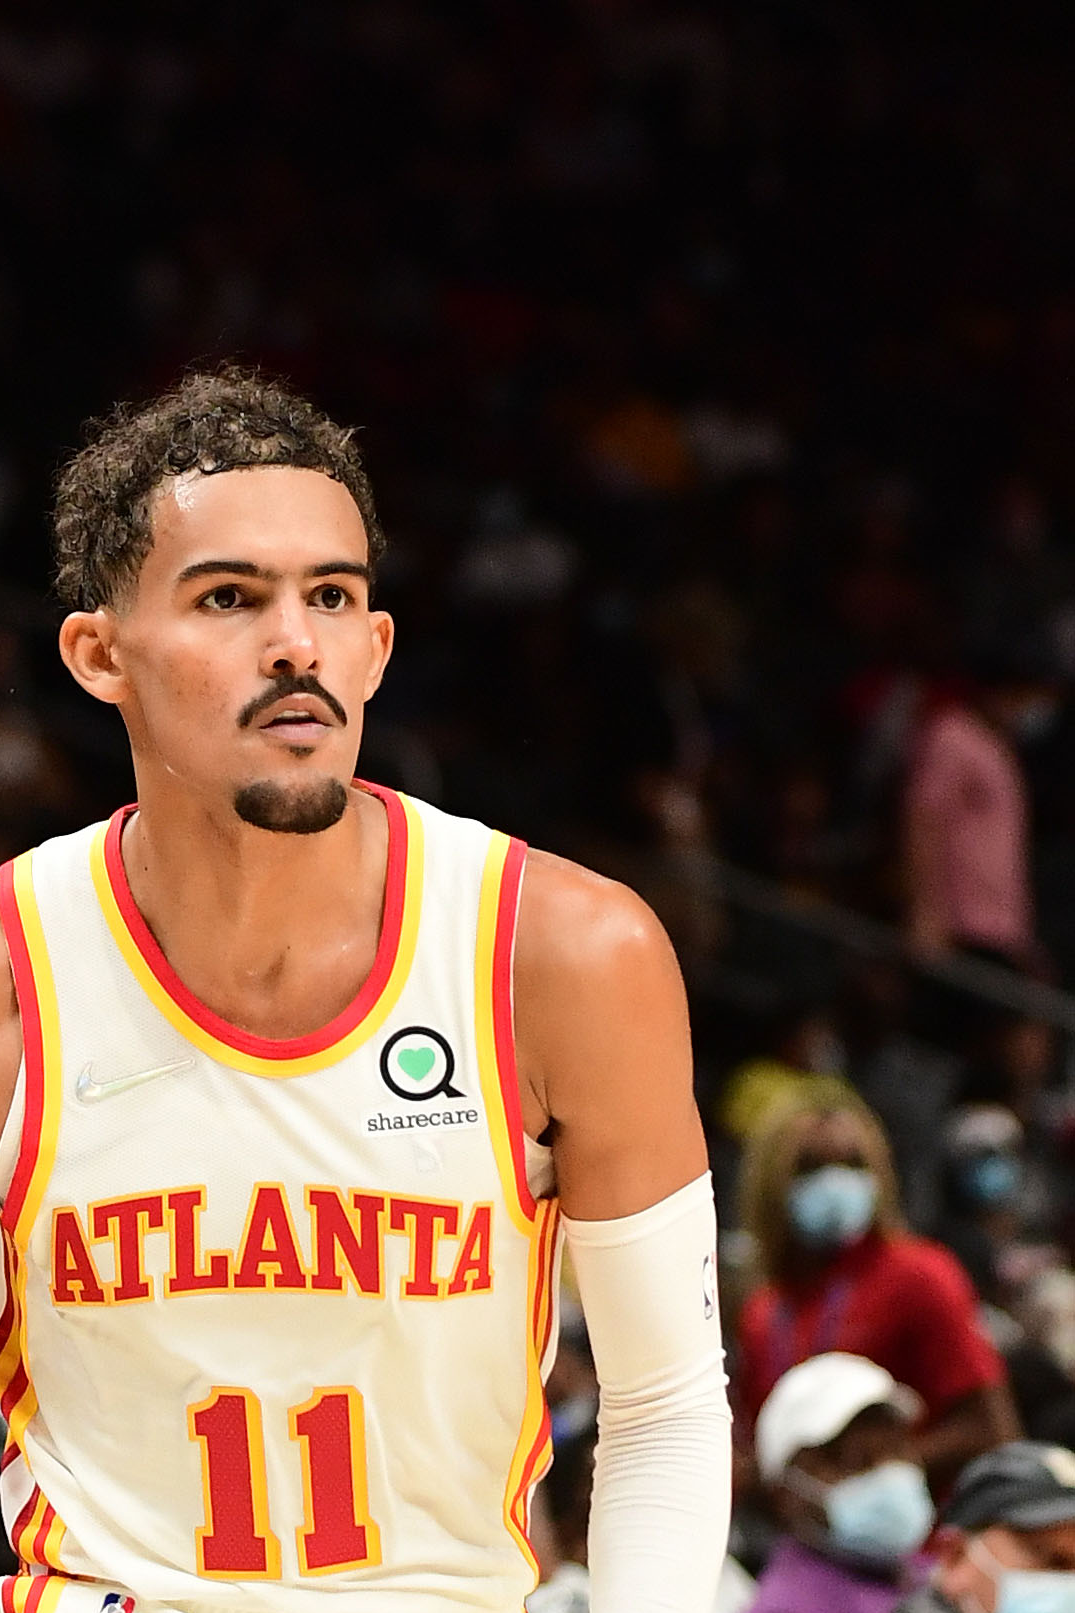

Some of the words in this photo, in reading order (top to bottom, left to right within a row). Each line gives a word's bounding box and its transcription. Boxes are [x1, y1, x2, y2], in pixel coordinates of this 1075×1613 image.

[367, 1108, 479, 1132] sharecare
[50, 1181, 495, 1306] ATLANTA
[186, 1385, 383, 1580] 11
